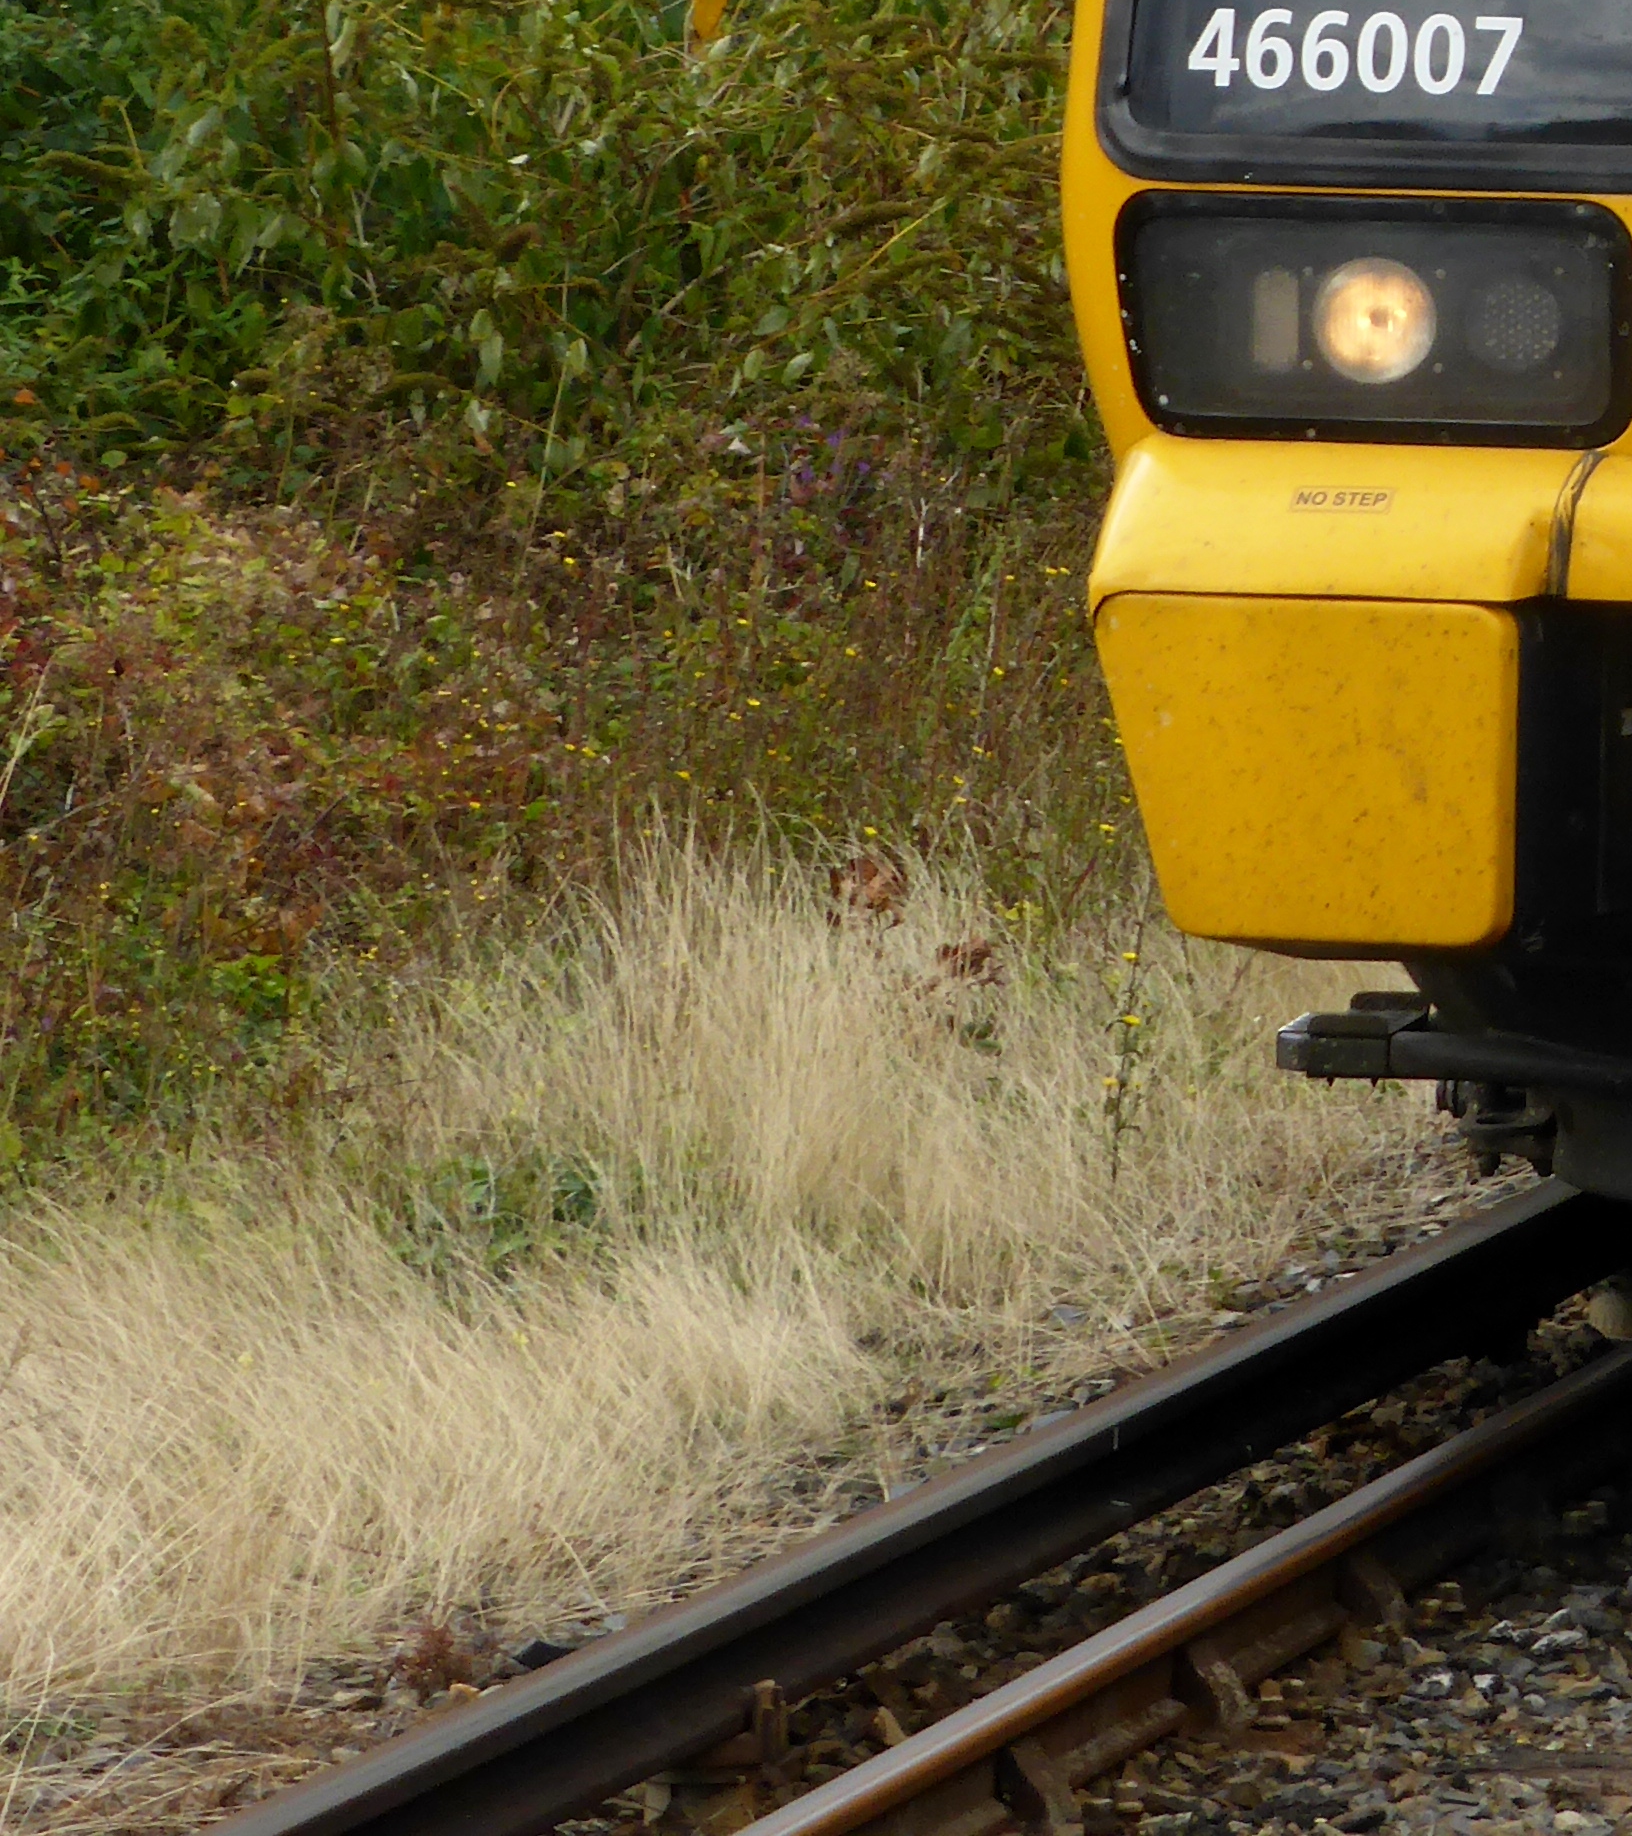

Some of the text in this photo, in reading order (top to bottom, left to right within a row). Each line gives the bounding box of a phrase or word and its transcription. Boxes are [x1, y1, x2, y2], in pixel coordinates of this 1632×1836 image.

[1187, 7, 1524, 96] 466007
[1296, 491, 1388, 506] NO STEP
